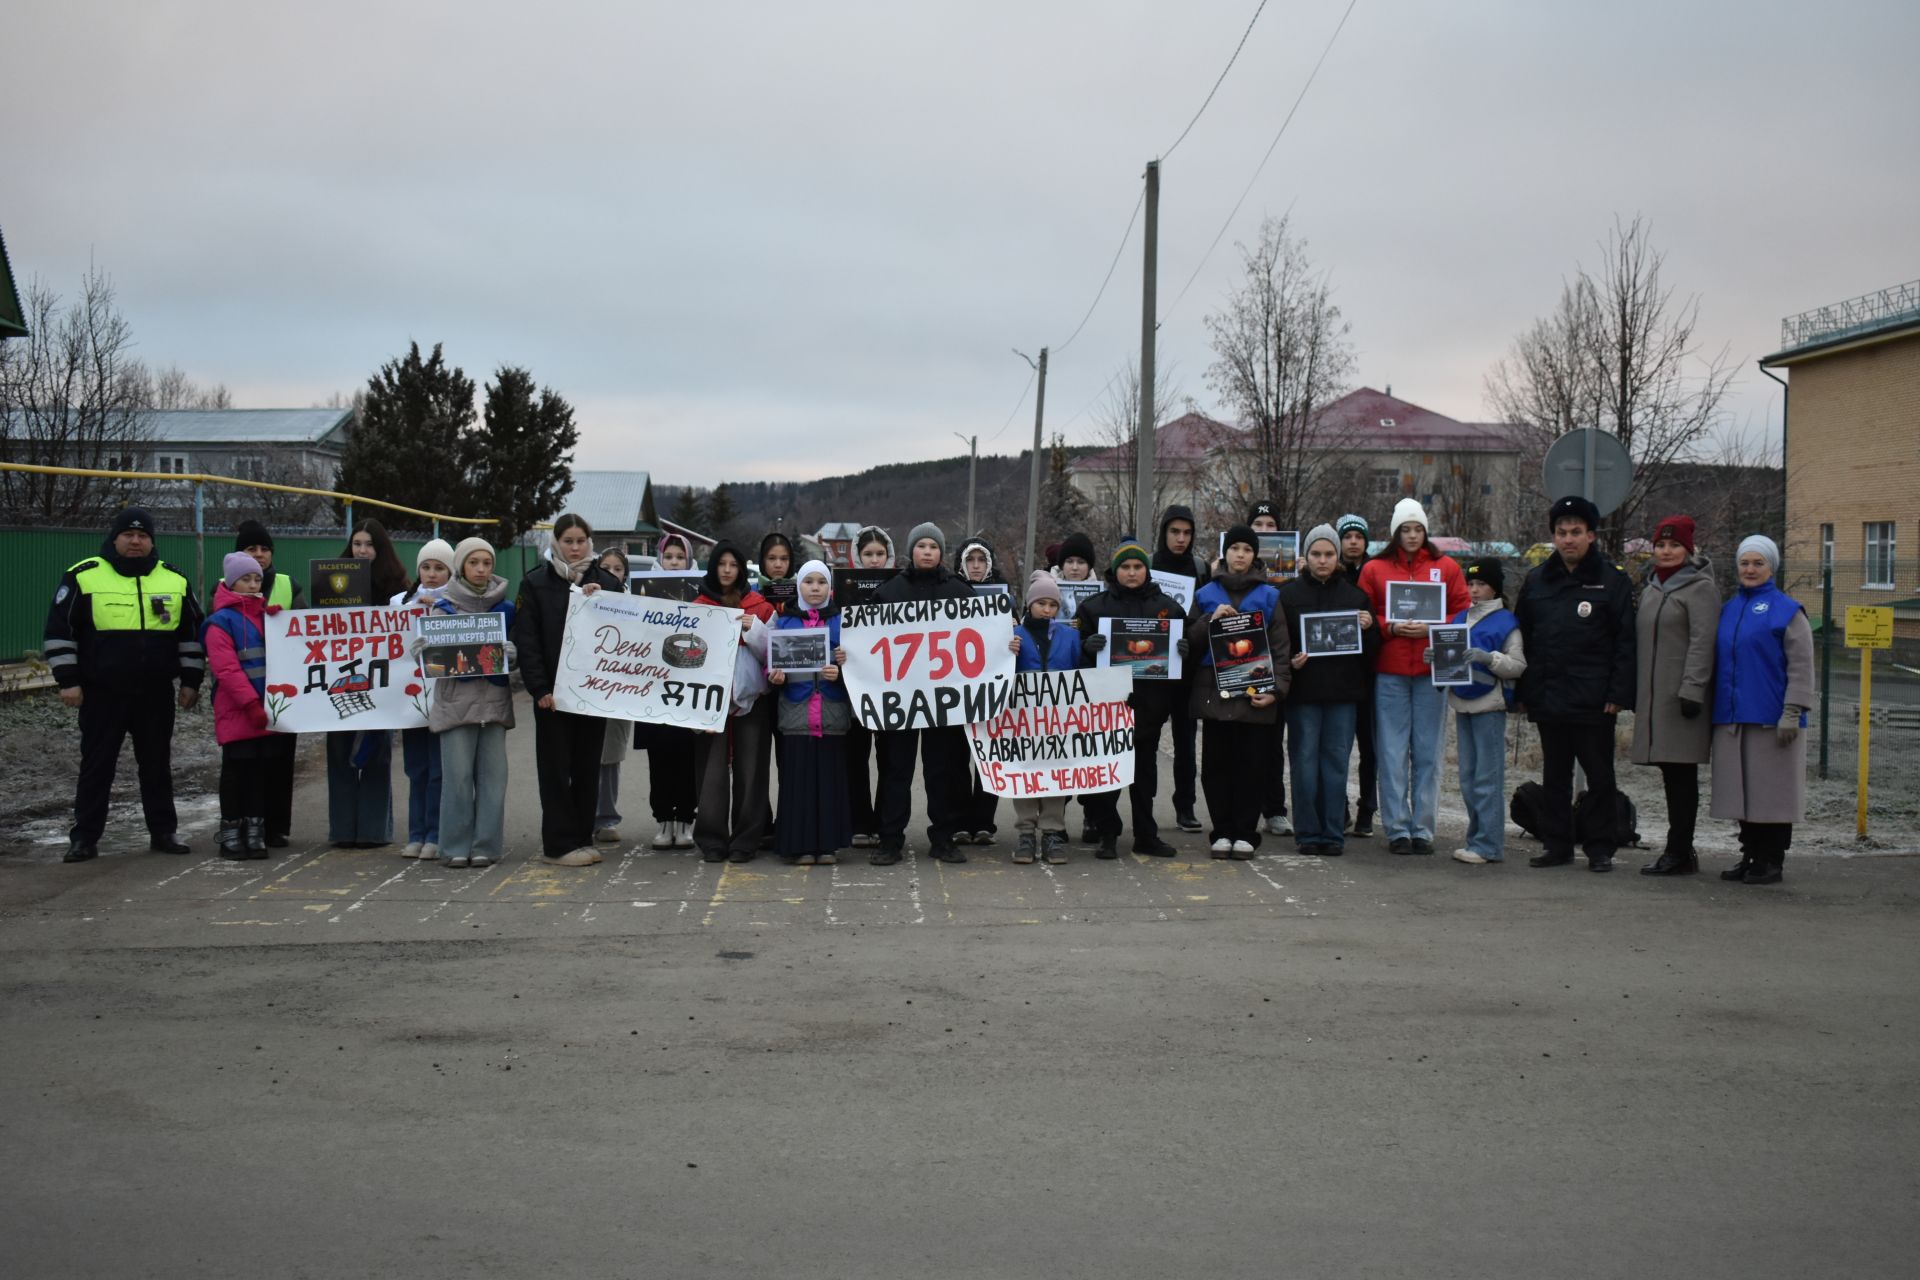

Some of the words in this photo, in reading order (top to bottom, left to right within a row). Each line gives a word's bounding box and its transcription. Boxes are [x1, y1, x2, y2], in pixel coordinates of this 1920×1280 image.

[319, 596, 363, 605] ИСПОЛЬЗУЙ
[841, 593, 1012, 628] ЗАФИКСИРОВАНО
[285, 613, 348, 638] ДЕНЬ
[348, 608, 430, 634] ПАМЯТ
[424, 616, 476, 630] ВСЕМИРНЫЙ
[478, 617, 499, 629] ДЕНЬ
[642, 606, 700, 633] ноября
[303, 633, 404, 664] ЖЕРТВ
[458, 632, 486, 643] ЖЕРТВ
[487, 631, 503, 642] ДТП
[594, 624, 653, 659] День
[595, 657, 671, 680] памяти
[870, 628, 986, 682] 1750
[303, 658, 389, 694] ДТП
[579, 674, 654, 700] жертв
[661, 680, 725, 713] ДТП
[861, 674, 1009, 731] АВАРИЙ
[1034, 705, 1063, 736] НА
[1063, 700, 1135, 735] ДОРОГАХ
[973, 739, 987, 761] В
[989, 734, 1068, 762] АВАРИЯХ
[1072, 727, 1135, 758] ПОГИБЛО
[1005, 771, 1049, 795] ТЫС.
[1051, 761, 1121, 790] ЧЕЛОВЕК
